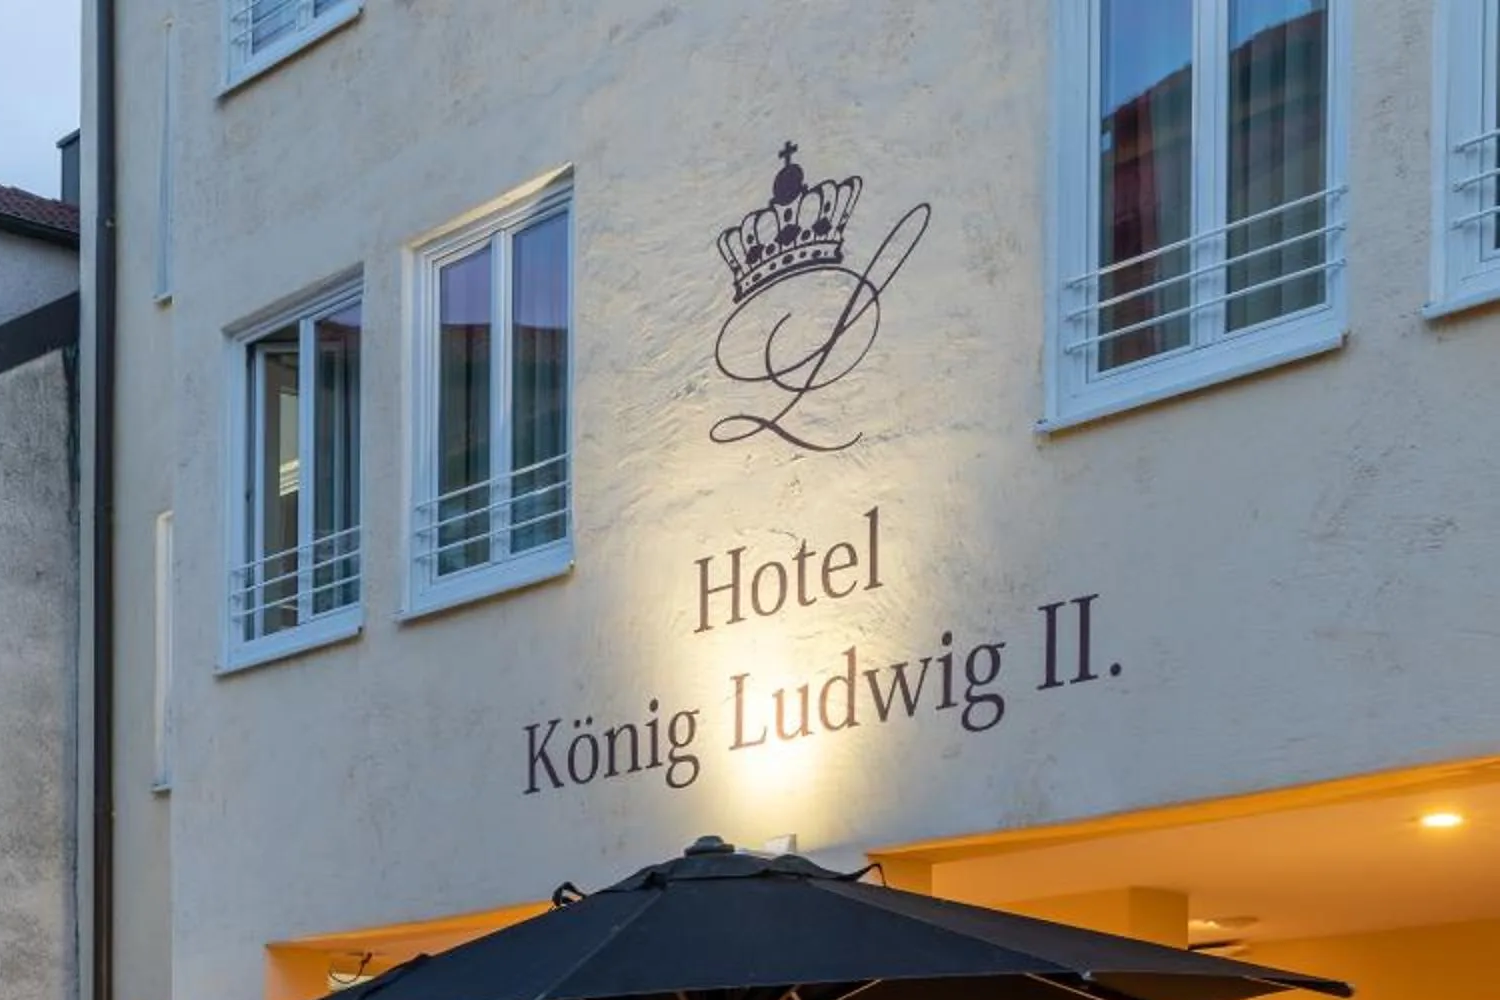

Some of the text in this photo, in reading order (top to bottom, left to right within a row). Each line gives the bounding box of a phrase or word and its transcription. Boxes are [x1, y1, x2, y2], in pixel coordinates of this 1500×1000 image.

[692, 507, 884, 633] Hotel
[523, 594, 1123, 794] König Ludwig II.
